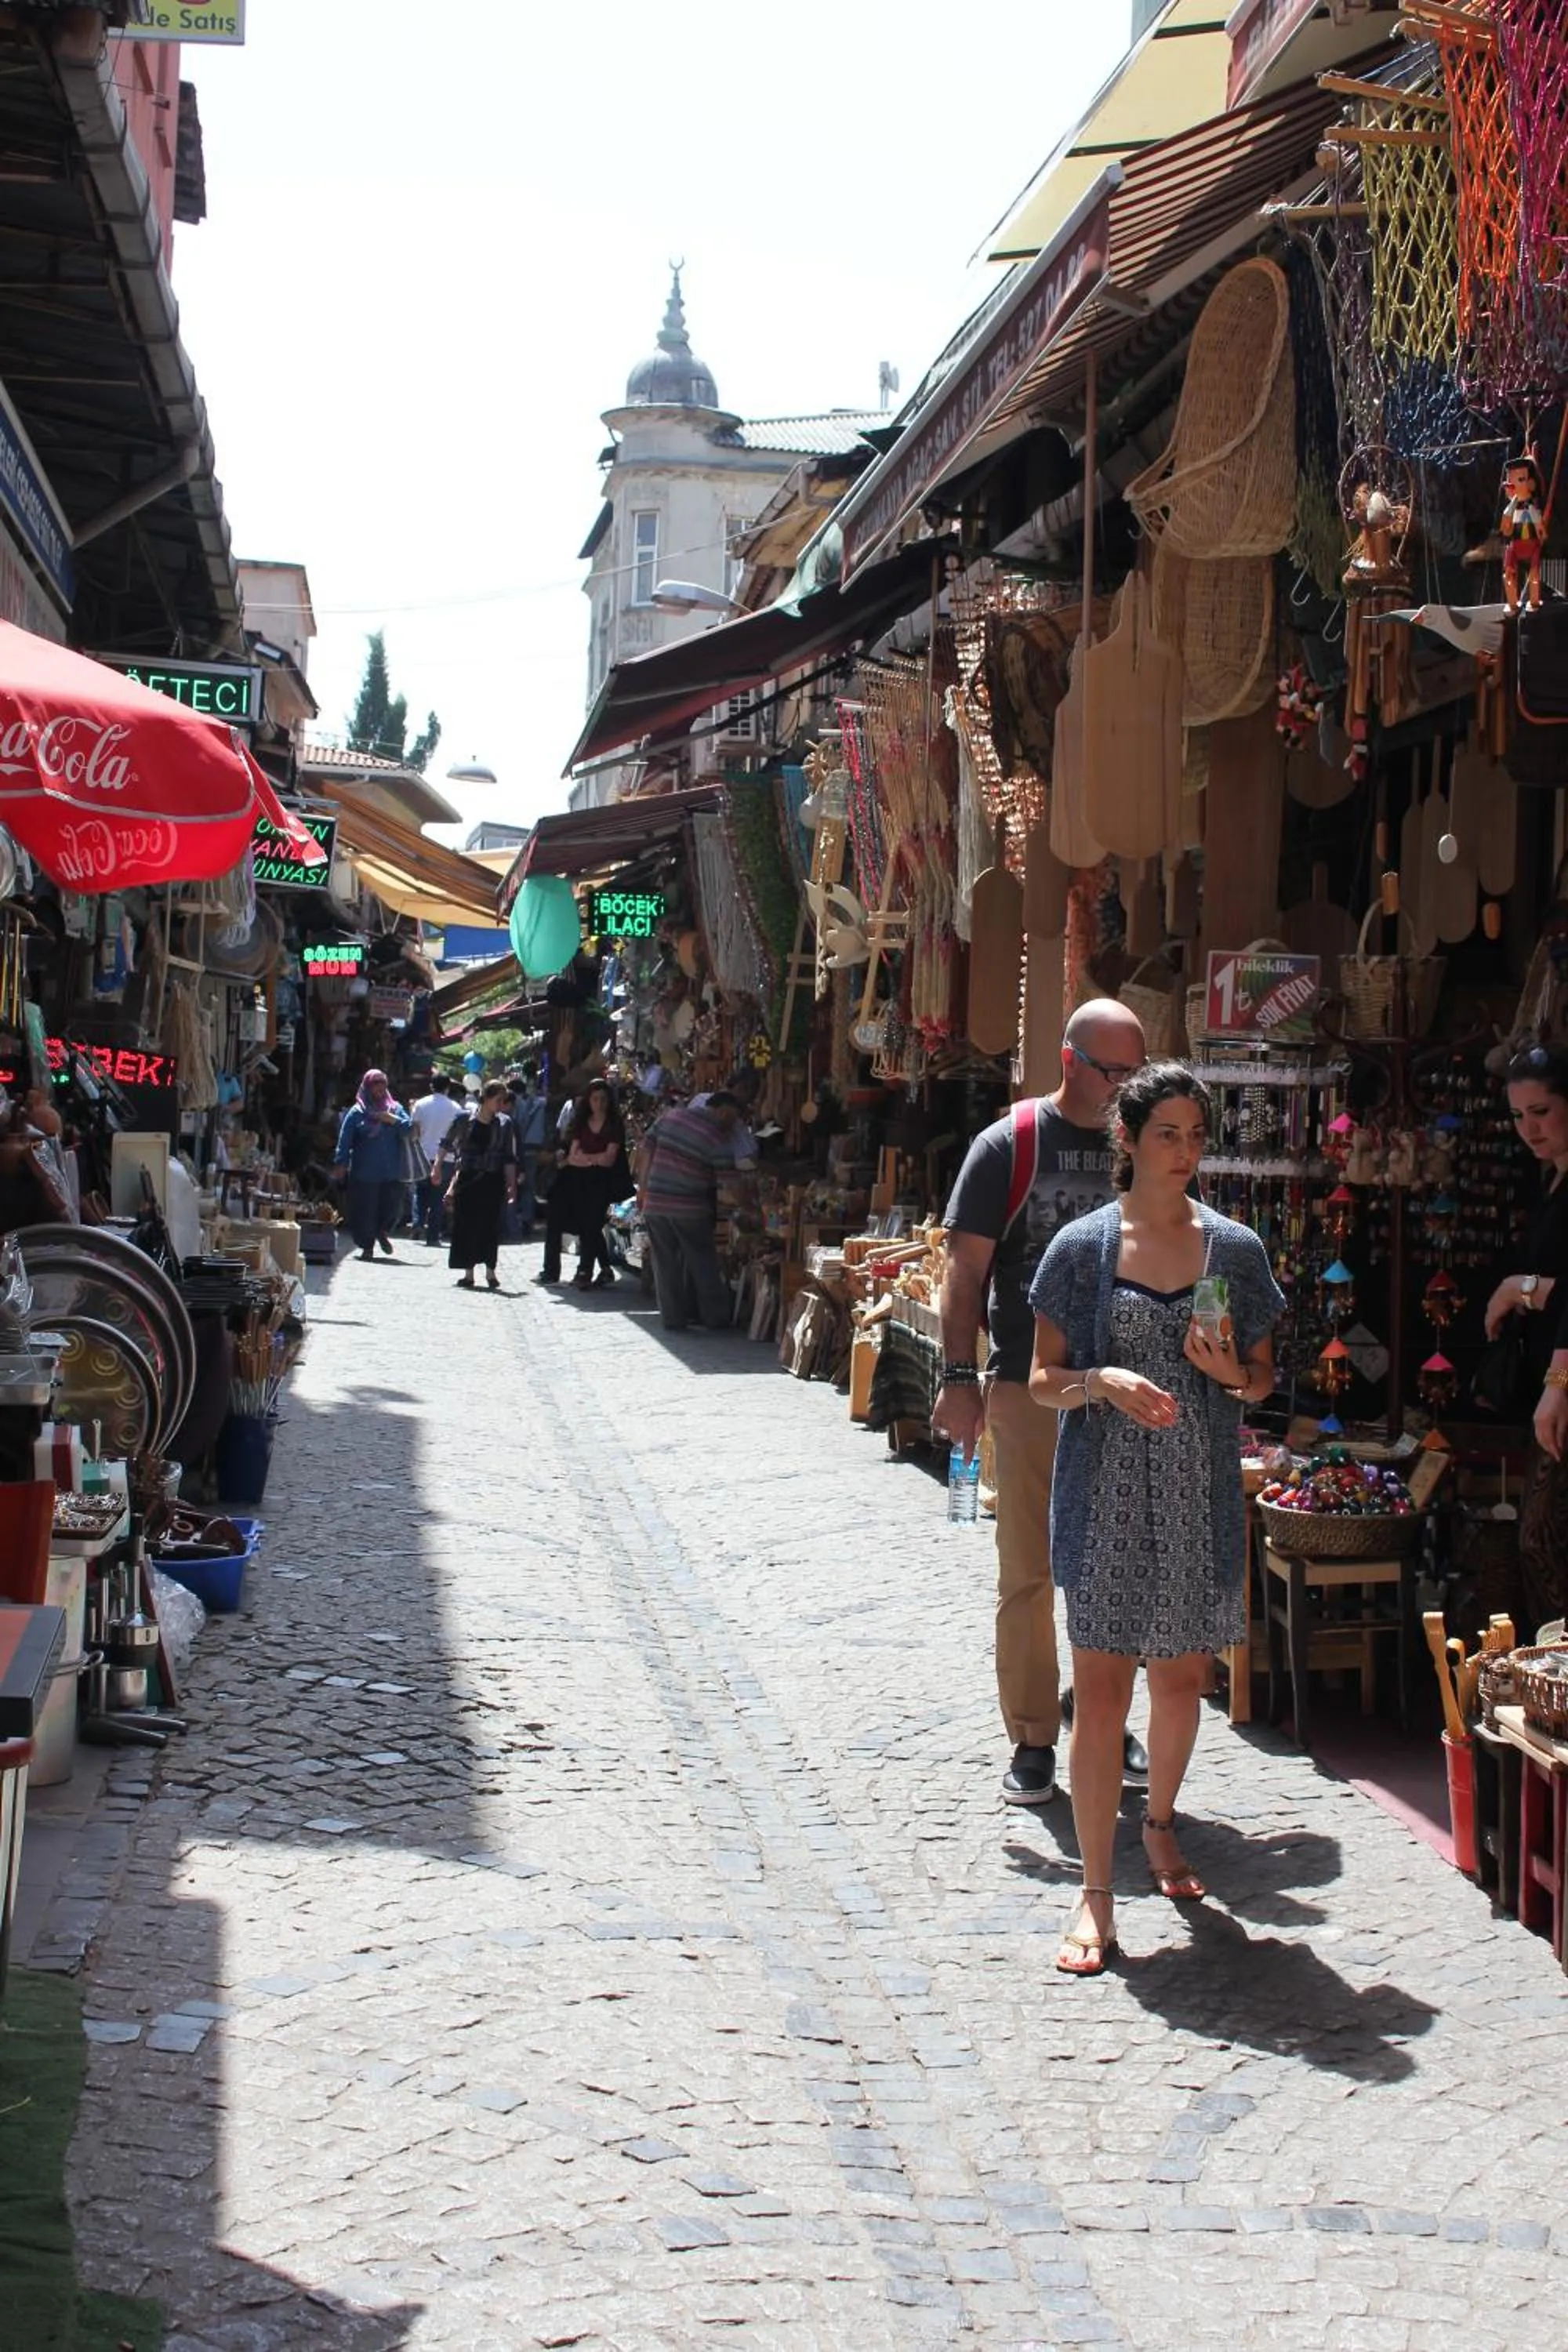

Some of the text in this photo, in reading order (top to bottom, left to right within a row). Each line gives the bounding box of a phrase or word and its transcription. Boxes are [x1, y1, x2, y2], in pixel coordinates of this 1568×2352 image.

[180, 9, 236, 34] Satış
[126, 668, 248, 714] FTECİ
[600, 895, 658, 916] BÖCEK
[1214, 958, 1236, 1025] 1
[1276, 975, 1316, 1014] FİYAT
[1058, 1150, 1114, 1172] THE BEAT
